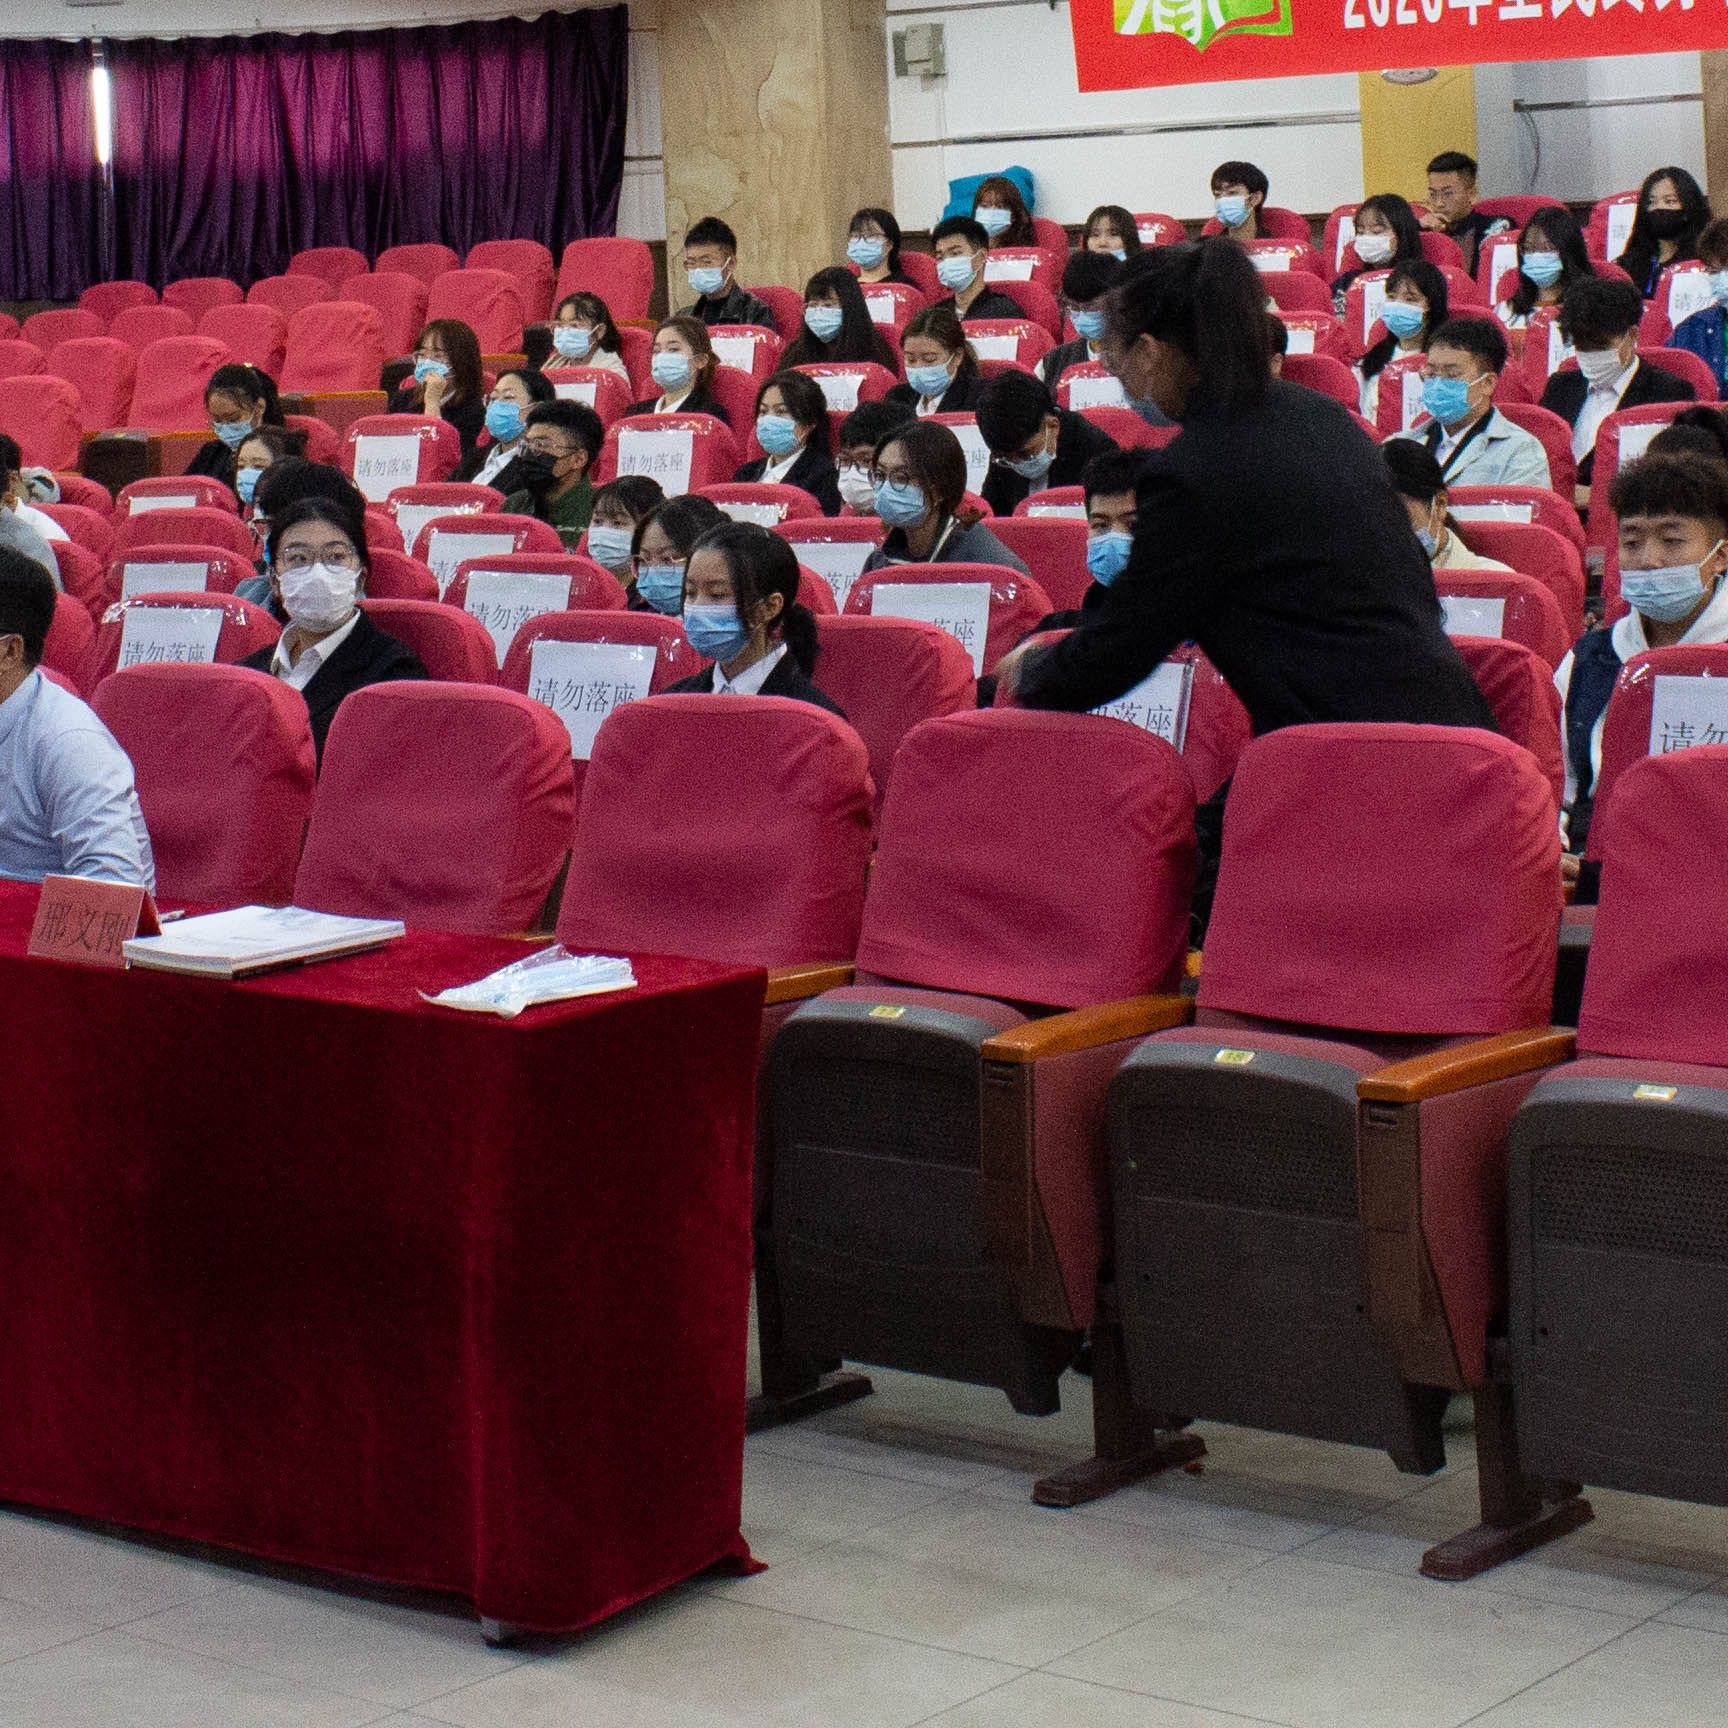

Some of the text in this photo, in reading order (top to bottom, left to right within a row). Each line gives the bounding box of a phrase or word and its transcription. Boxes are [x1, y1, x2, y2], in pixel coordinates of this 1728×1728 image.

[621, 453, 684, 474] 请勿落座
[471, 603, 555, 631] 请勿落
[533, 678, 636, 713] 请勿落座
